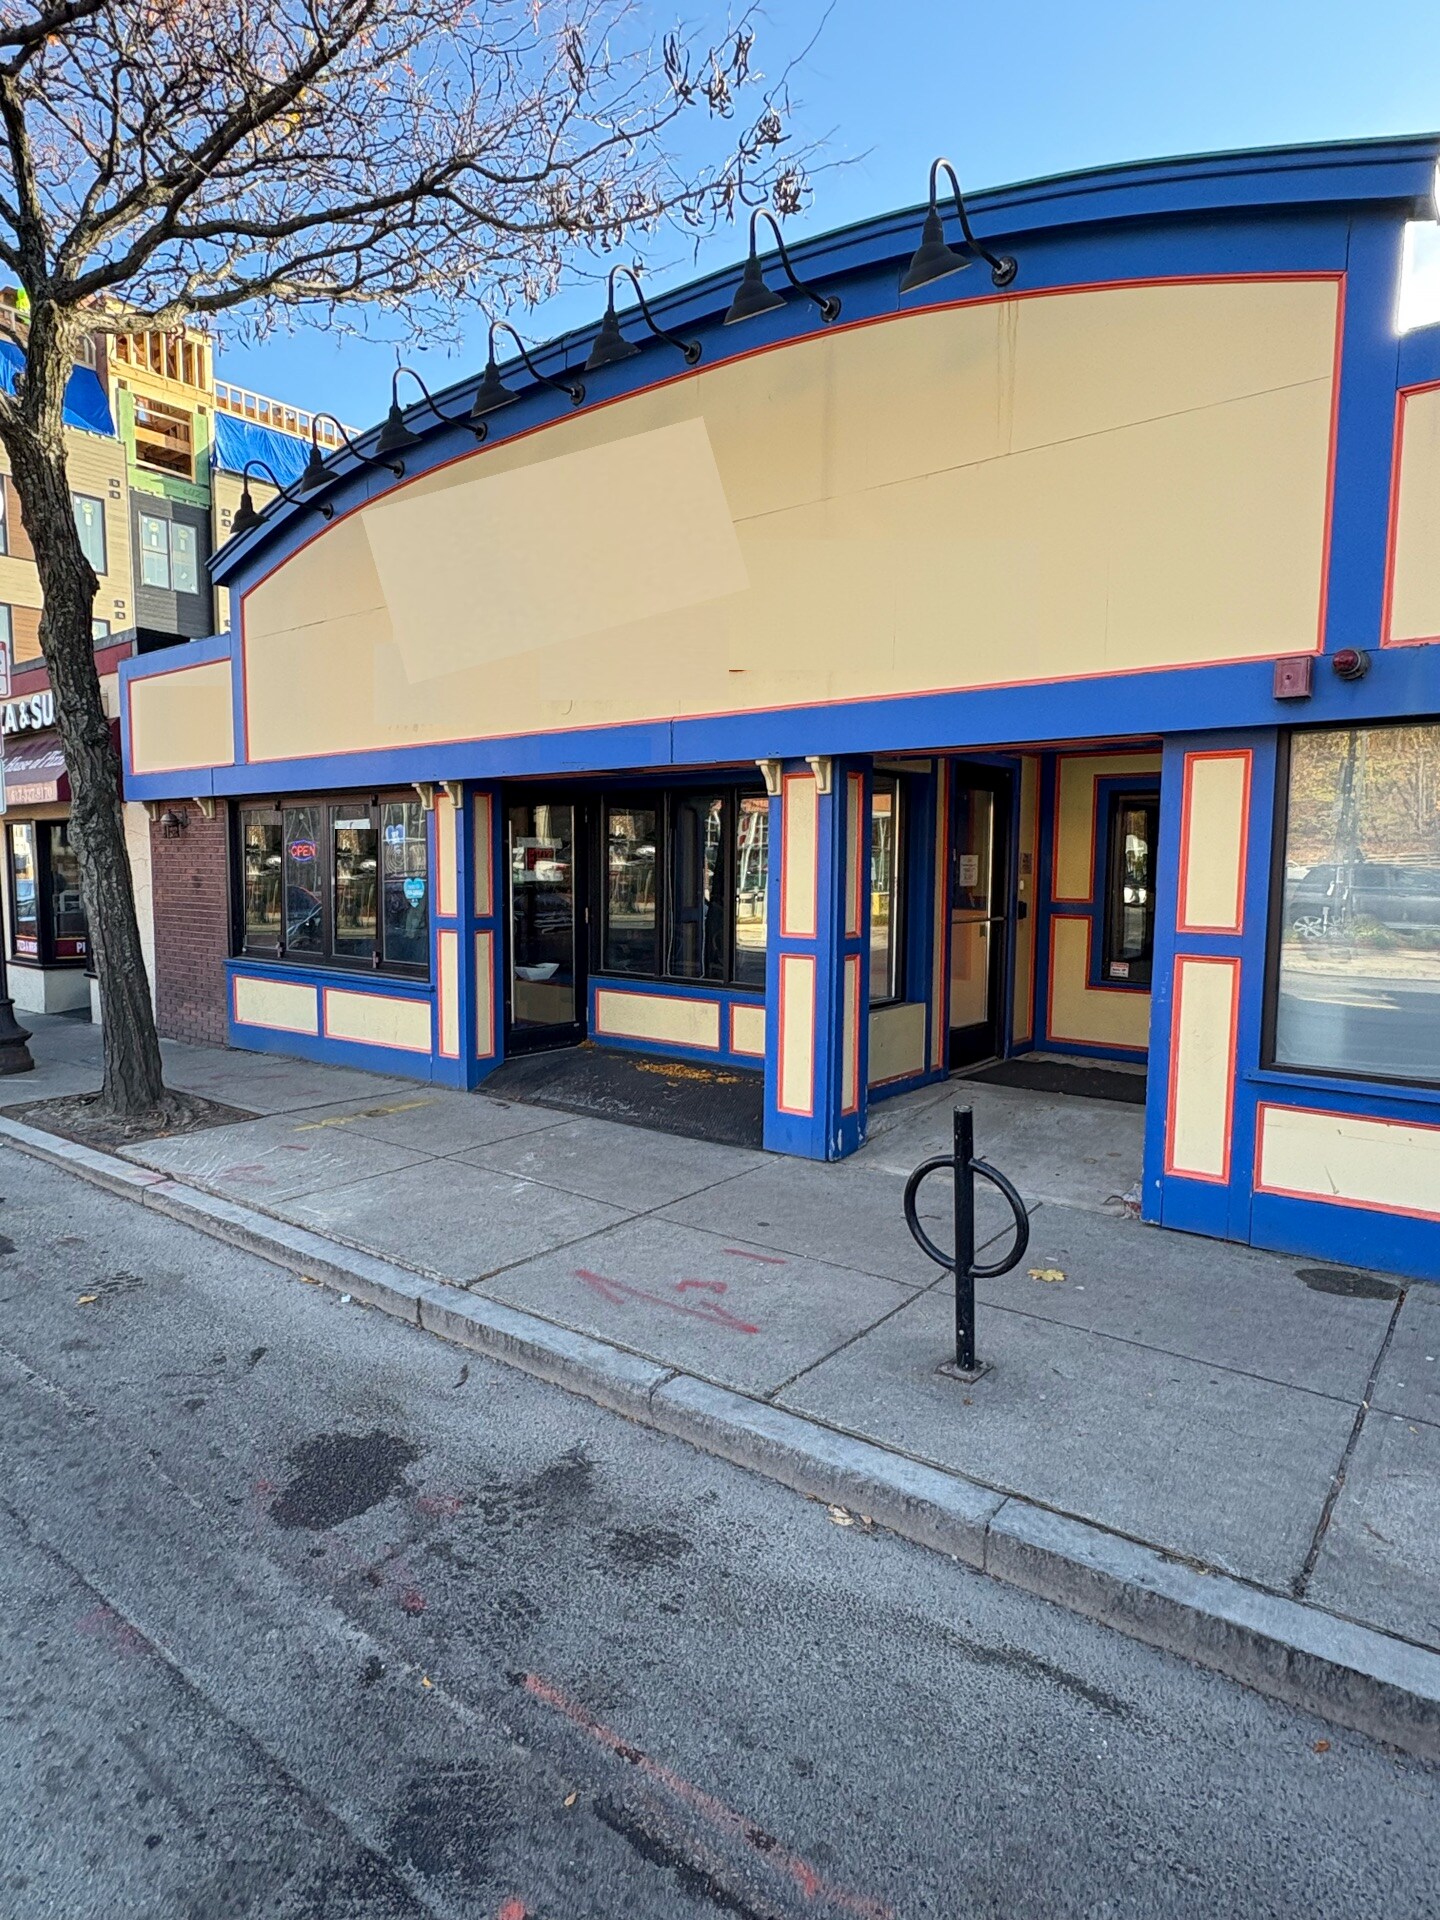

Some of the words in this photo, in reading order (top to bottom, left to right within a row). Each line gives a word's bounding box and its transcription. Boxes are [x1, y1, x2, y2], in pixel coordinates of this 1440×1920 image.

[19, 701, 31, 729] &
[31, 692, 56, 729] SU
[289, 842, 308, 851] OPEN
